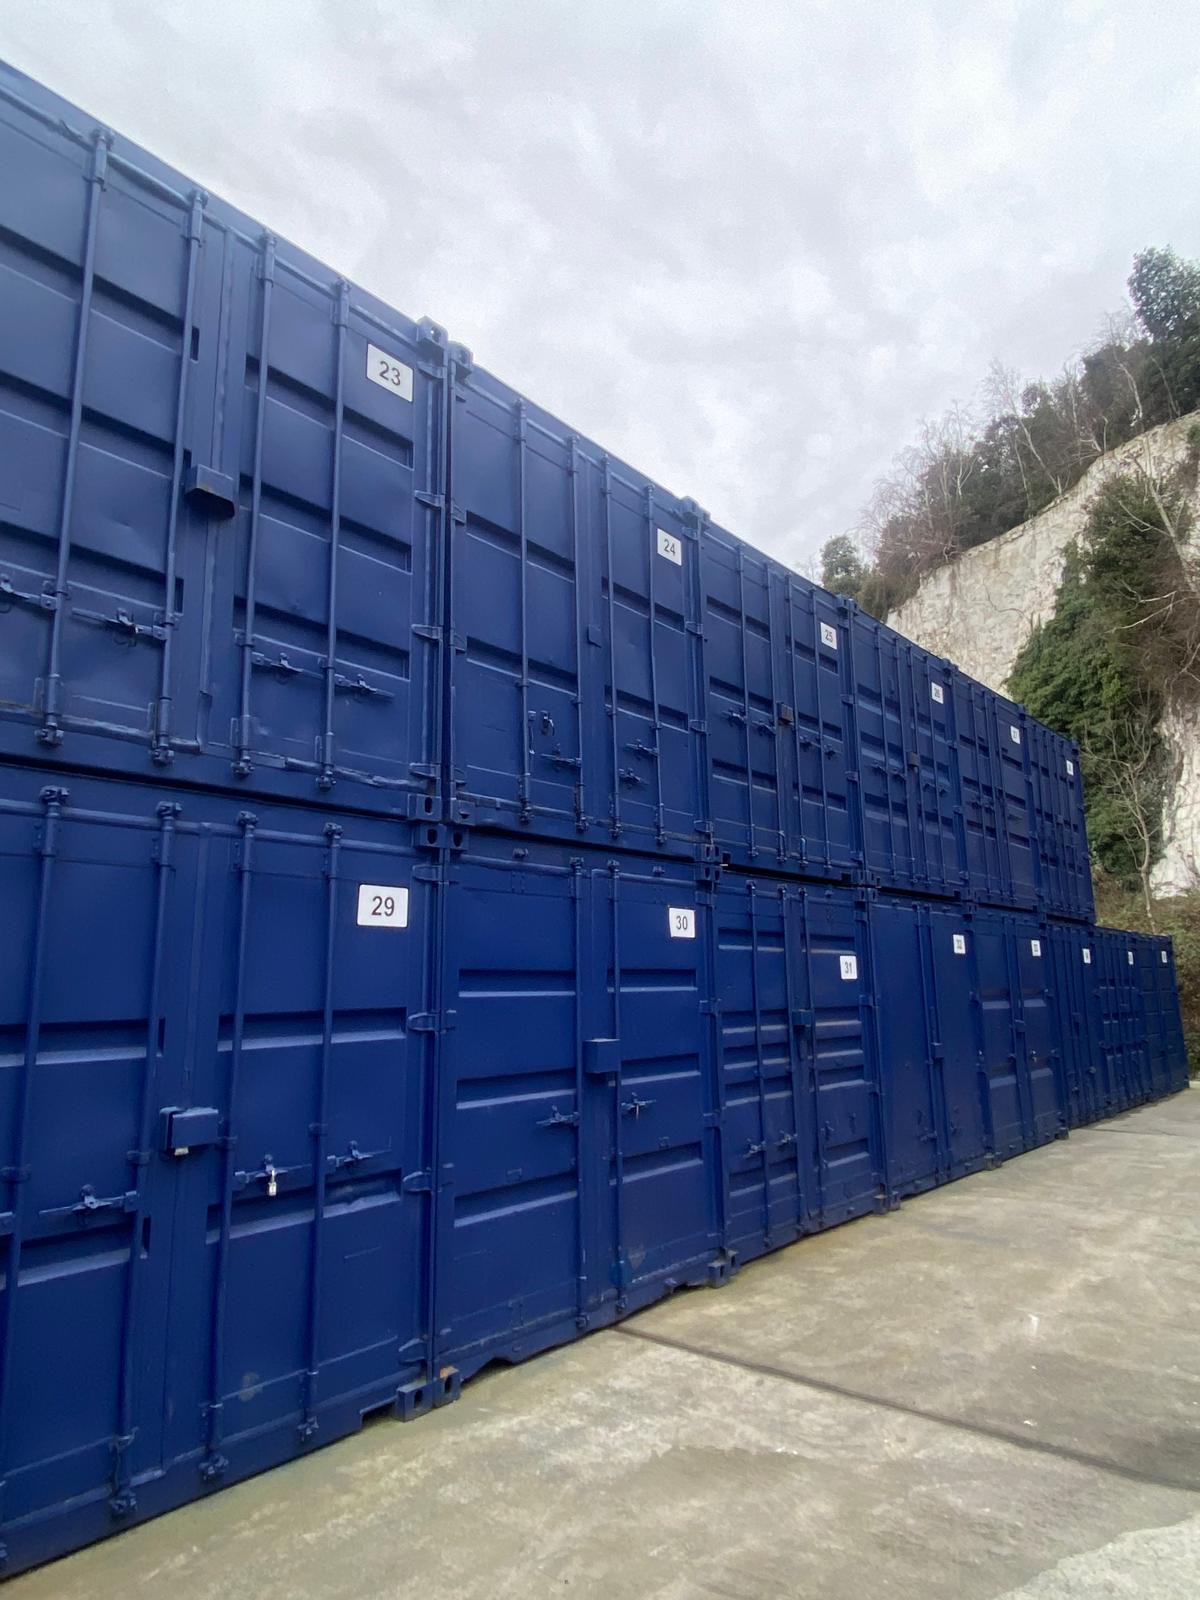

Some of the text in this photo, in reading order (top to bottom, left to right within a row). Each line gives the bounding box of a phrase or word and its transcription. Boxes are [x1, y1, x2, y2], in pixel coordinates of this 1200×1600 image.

[380, 361, 401, 386] 23
[663, 538, 676, 556] 24
[824, 629, 833, 643] 25
[372, 896, 395, 917] 29
[675, 915, 688, 930] 30
[844, 961, 853, 974] 31
